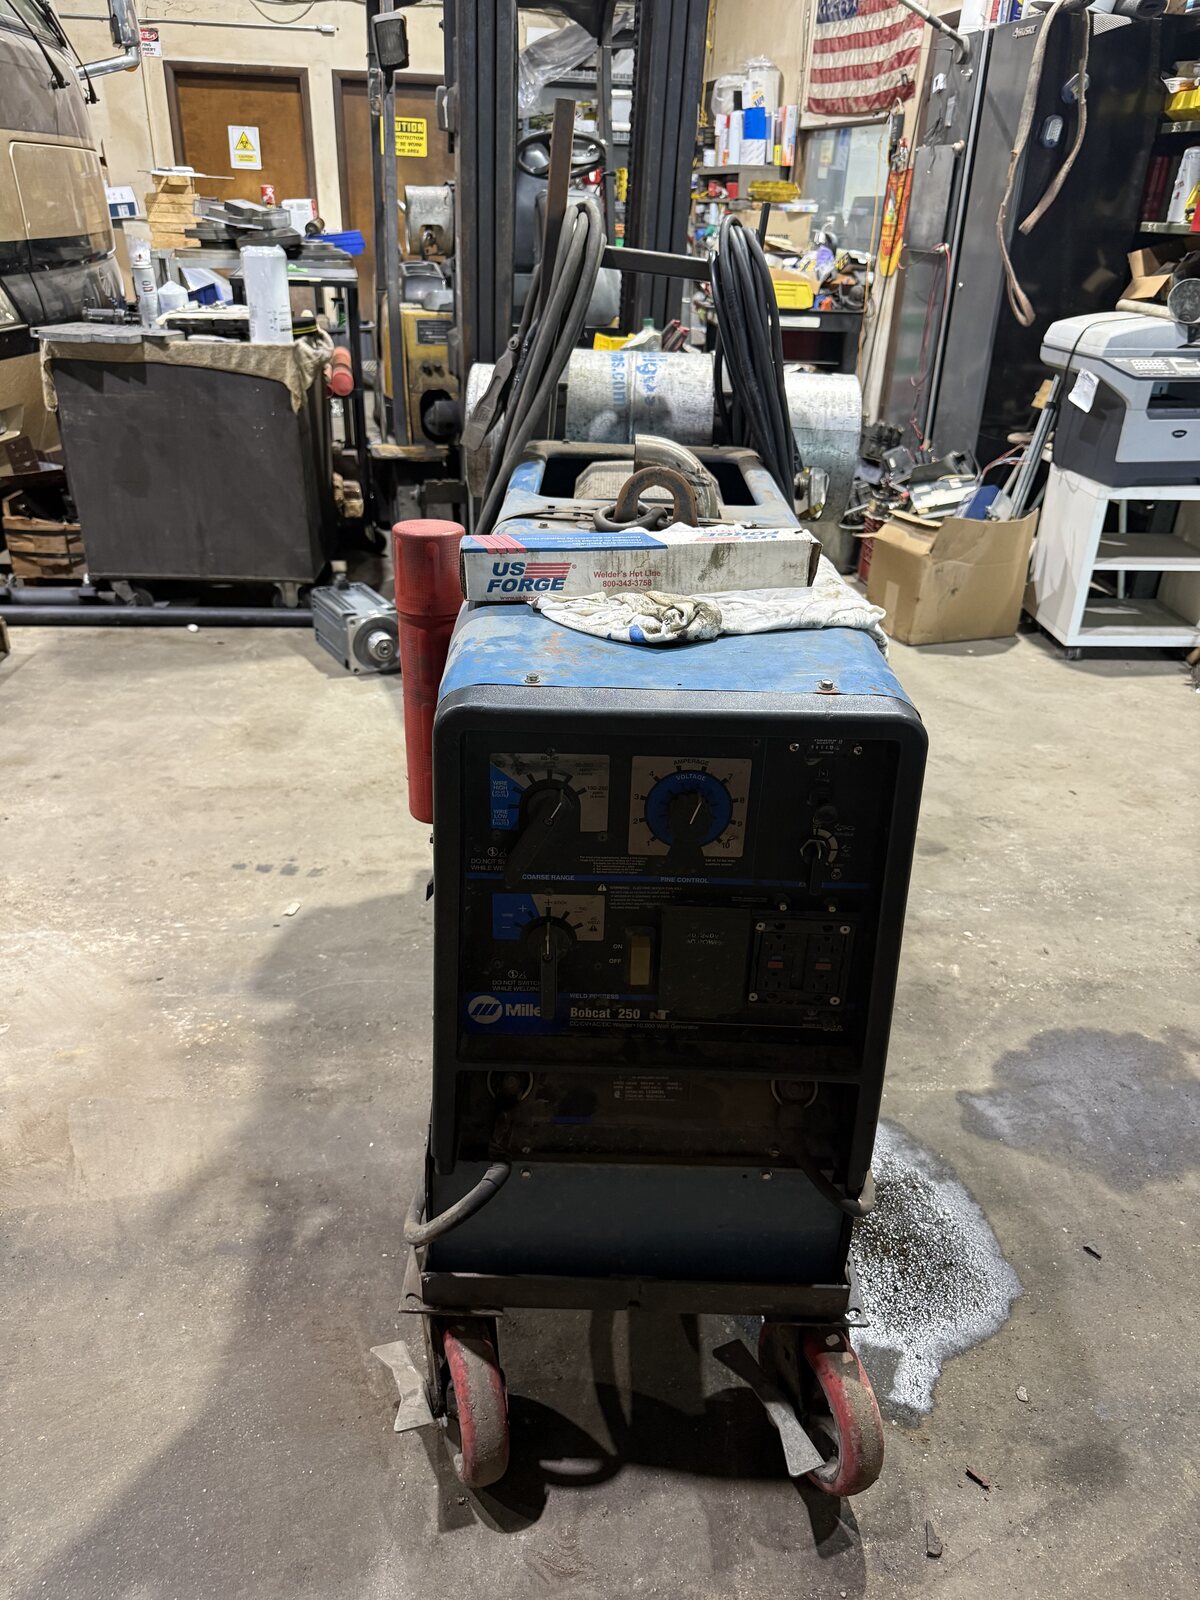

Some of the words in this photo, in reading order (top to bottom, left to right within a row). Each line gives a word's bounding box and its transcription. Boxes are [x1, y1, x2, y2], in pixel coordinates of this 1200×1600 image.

[492, 562, 526, 577] US
[593, 571, 627, 579] Welder's
[487, 577, 567, 593] FORGE
[602, 580, 652, 588] 800-343-3758
[673, 758, 709, 766] AMPERAGE
[676, 774, 707, 782] VOLTAGE
[505, 1003, 541, 1017] Mille
[570, 1007, 611, 1019] Bobcat
[618, 1008, 641, 1019] 250
